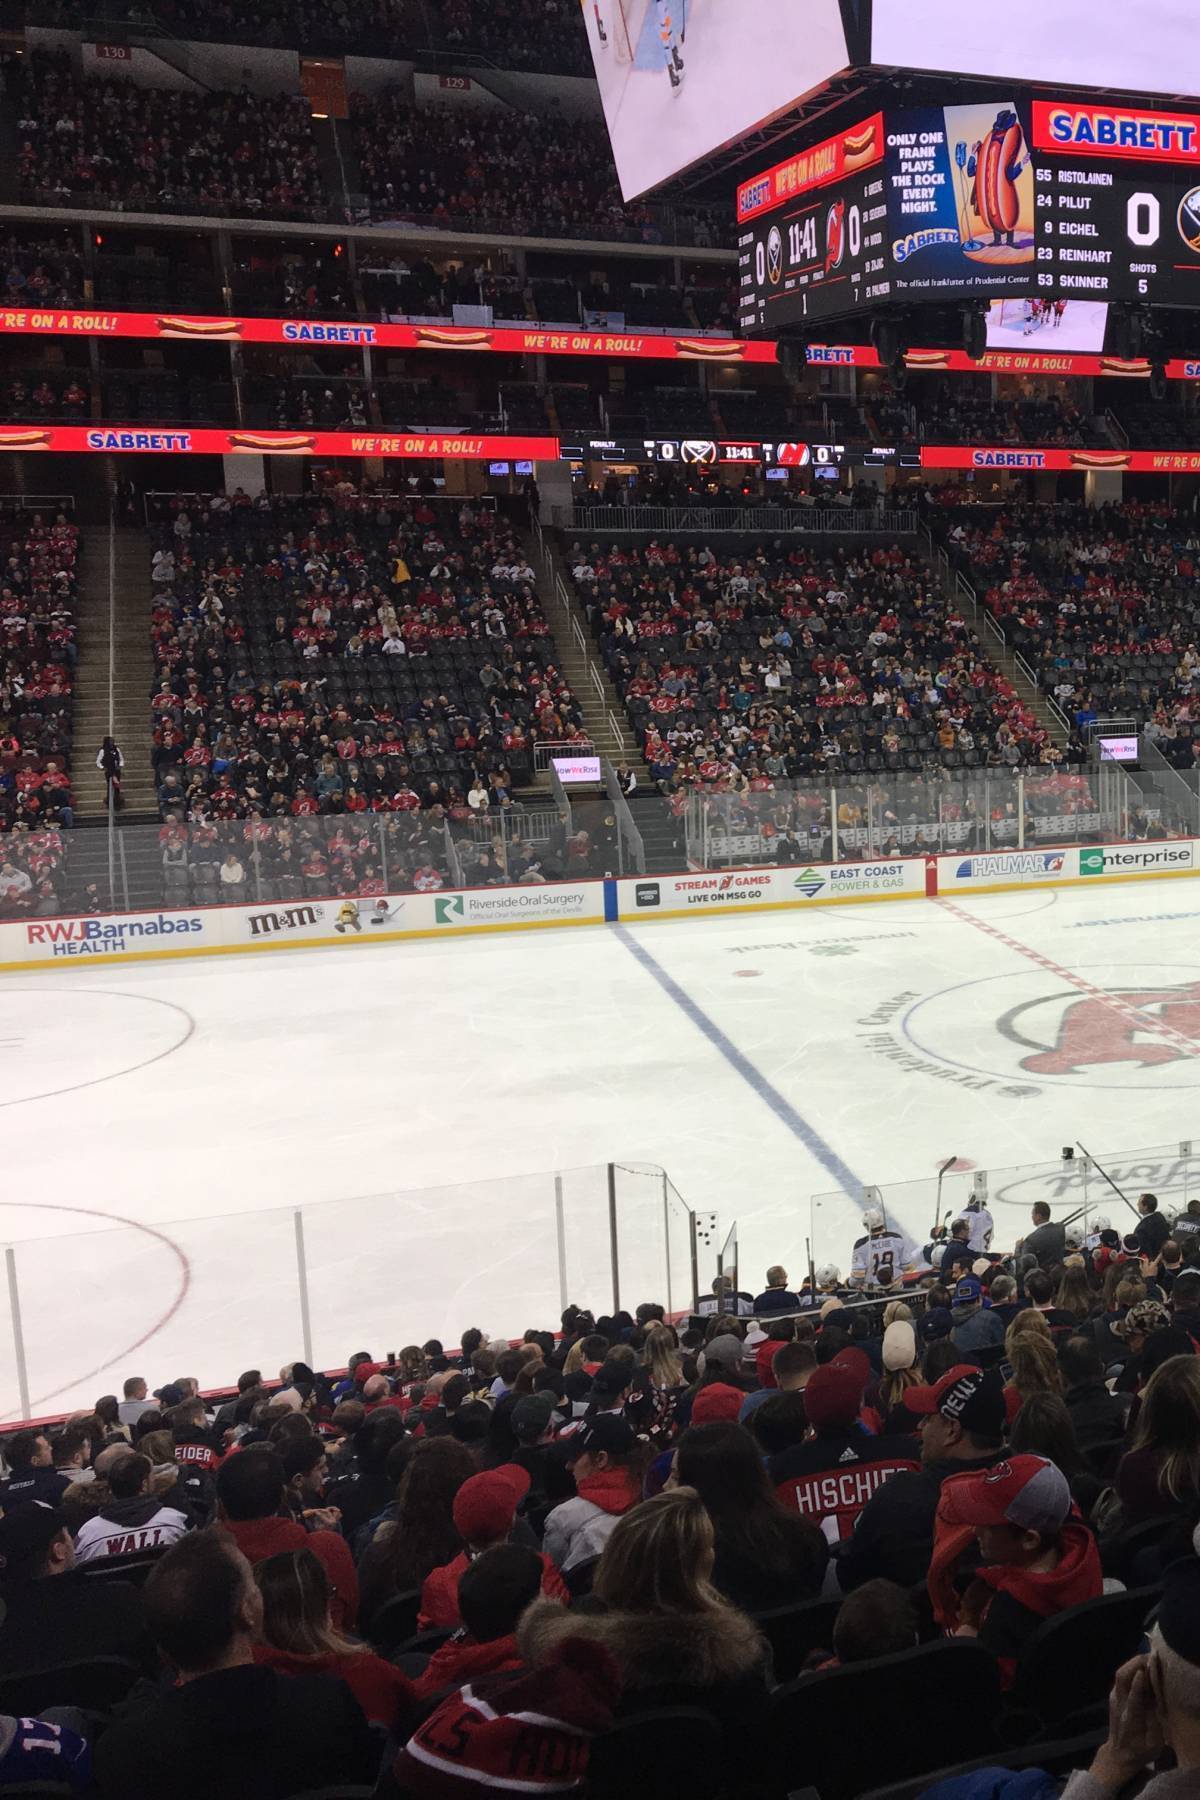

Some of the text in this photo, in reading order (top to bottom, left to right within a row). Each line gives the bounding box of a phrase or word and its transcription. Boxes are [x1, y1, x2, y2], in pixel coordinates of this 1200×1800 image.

[104, 46, 125, 58] 130
[446, 77, 464, 88] 129
[1050, 110, 1198, 152] SABRETT
[887, 132, 944, 146] ONLY ONE
[899, 146, 936, 159] FRANK
[901, 160, 934, 173] PLAYS
[892, 173, 945, 187] THE ROCK
[1036, 169, 1113, 186] 55 RISTOLAINEN
[902, 187, 935, 200] EVERY
[901, 201, 938, 214] NIGHT.
[1036, 195, 1091, 209] 24 PILUT
[1127, 192, 1160, 246] 0
[849, 205, 860, 257] 0
[1044, 222, 1099, 236] 9 EICHEL
[788, 217, 817, 265] 11:41
[893, 228, 959, 263] SABRETT
[1037, 248, 1112, 263] 23 REINHART
[755, 241, 765, 286] 0
[1129, 263, 1157, 274] SHOTS
[896, 275, 1030, 288] The official Prudential Center
[1037, 274, 1108, 289] 53 SKINNER
[1138, 279, 1148, 293] 5
[802, 293, 808, 315] 1
[31, 314, 117, 331] ON A ROLL!
[283, 322, 377, 343] SABRETT
[524, 334, 642, 352] WE'RE ON A ROLL!
[975, 354, 1073, 371] WE'RE ON A ROLL!
[88, 431, 192, 450] SABRETT
[351, 438, 483, 455] WE'RE ON A ROLL!
[662, 443, 673, 459] 0
[726, 446, 753, 459] 11:41
[817, 448, 828, 462] 0
[973, 450, 1045, 468] SABRETT
[1152, 455, 1187, 468] WE'RE
[972, 855, 1045, 877] HALMAR
[1081, 848, 1191, 870] enterprise
[830, 865, 904, 880] EAST COAST
[674, 876, 771, 891] STREAM GAMES
[830, 878, 904, 892] POWER & GAS
[469, 893, 585, 910] Riverside Oral Surgery
[688, 890, 761, 903] LIVE ON MSG GO
[53, 938, 125, 956] HEALTH
[855, 1032, 1000, 1090] Prudential
[795, 1468, 908, 1514] HISCHI
